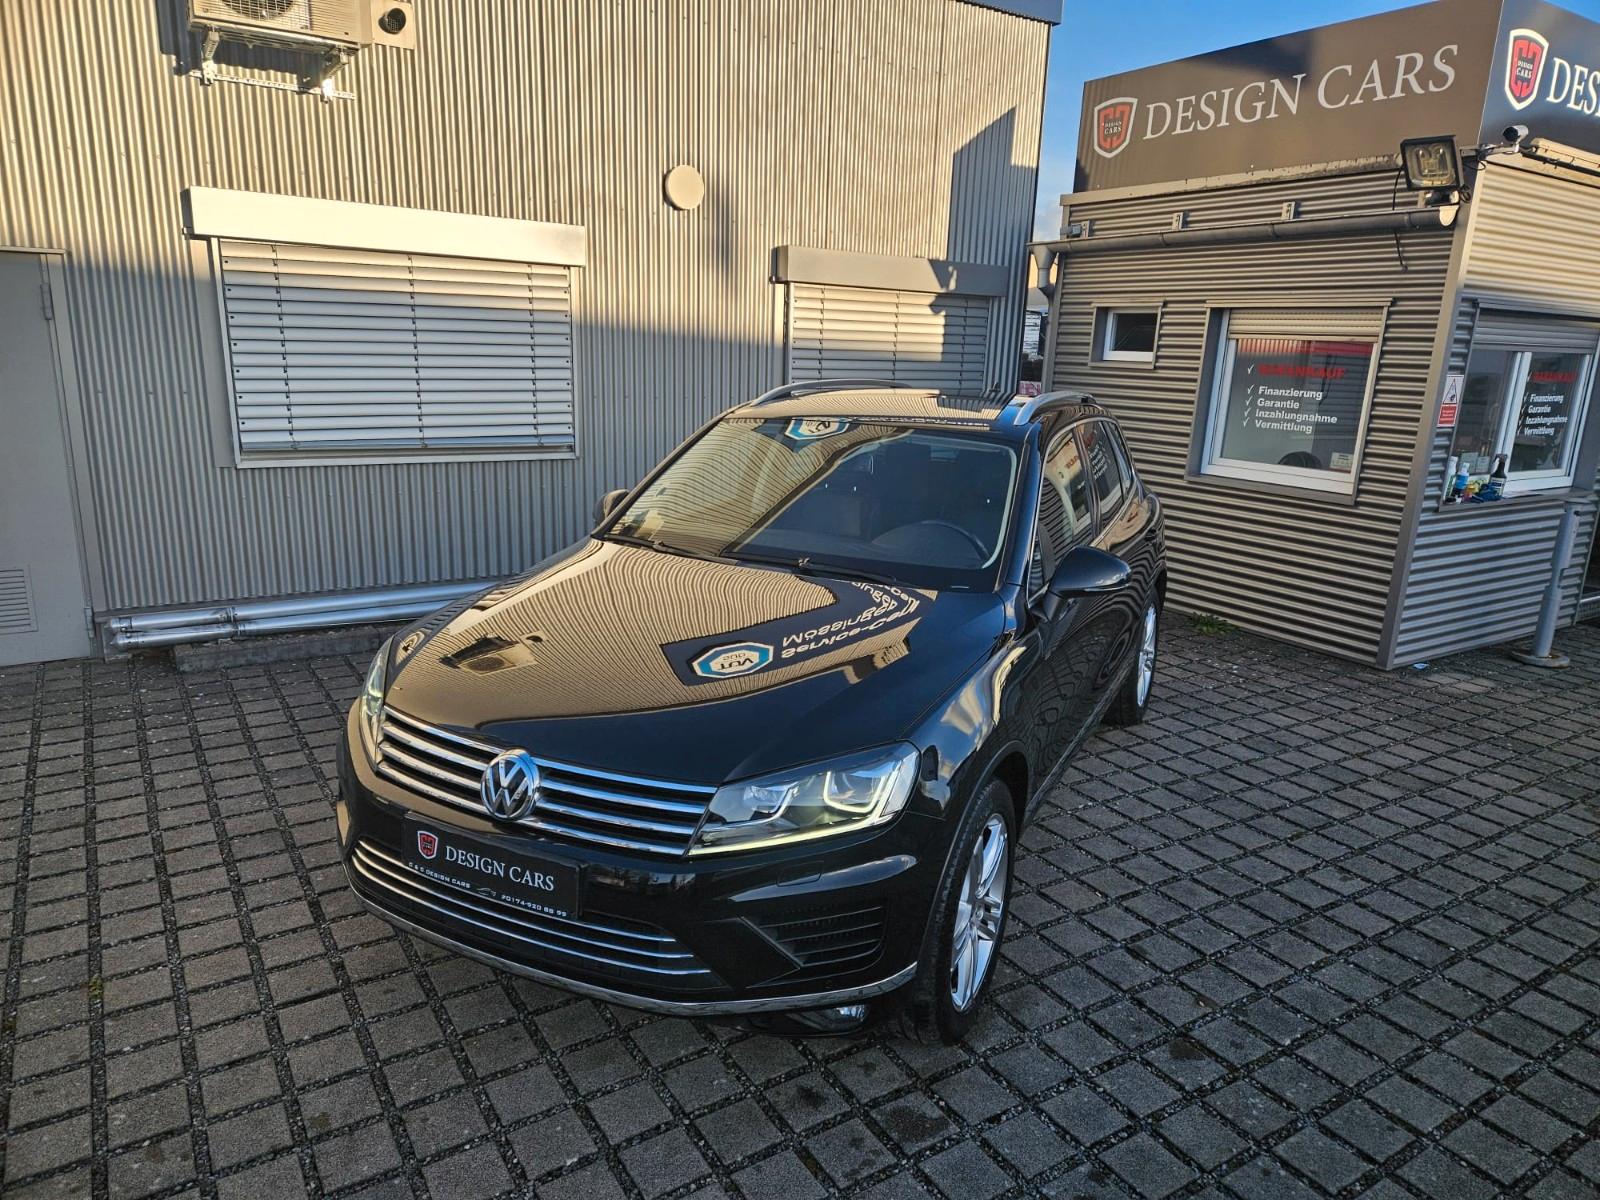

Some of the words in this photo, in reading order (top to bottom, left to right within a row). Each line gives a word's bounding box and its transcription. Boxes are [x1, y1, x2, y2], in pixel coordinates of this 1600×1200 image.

[1516, 68, 1532, 79] CARS
[1143, 73, 1306, 141] DESIGN
[1318, 44, 1459, 110] CARS
[1104, 127, 1122, 135] CARS
[1258, 386, 1323, 400] Finanzierung
[1257, 398, 1300, 409] Garantie
[1255, 409, 1338, 424] Inzahlungnahme
[1255, 420, 1313, 434] Vermittlung
[445, 845, 506, 878] DESIGN
[509, 866, 554, 891] CARS
[426, 870, 450, 882] DESIGN
[451, 878, 471, 889] CARS
